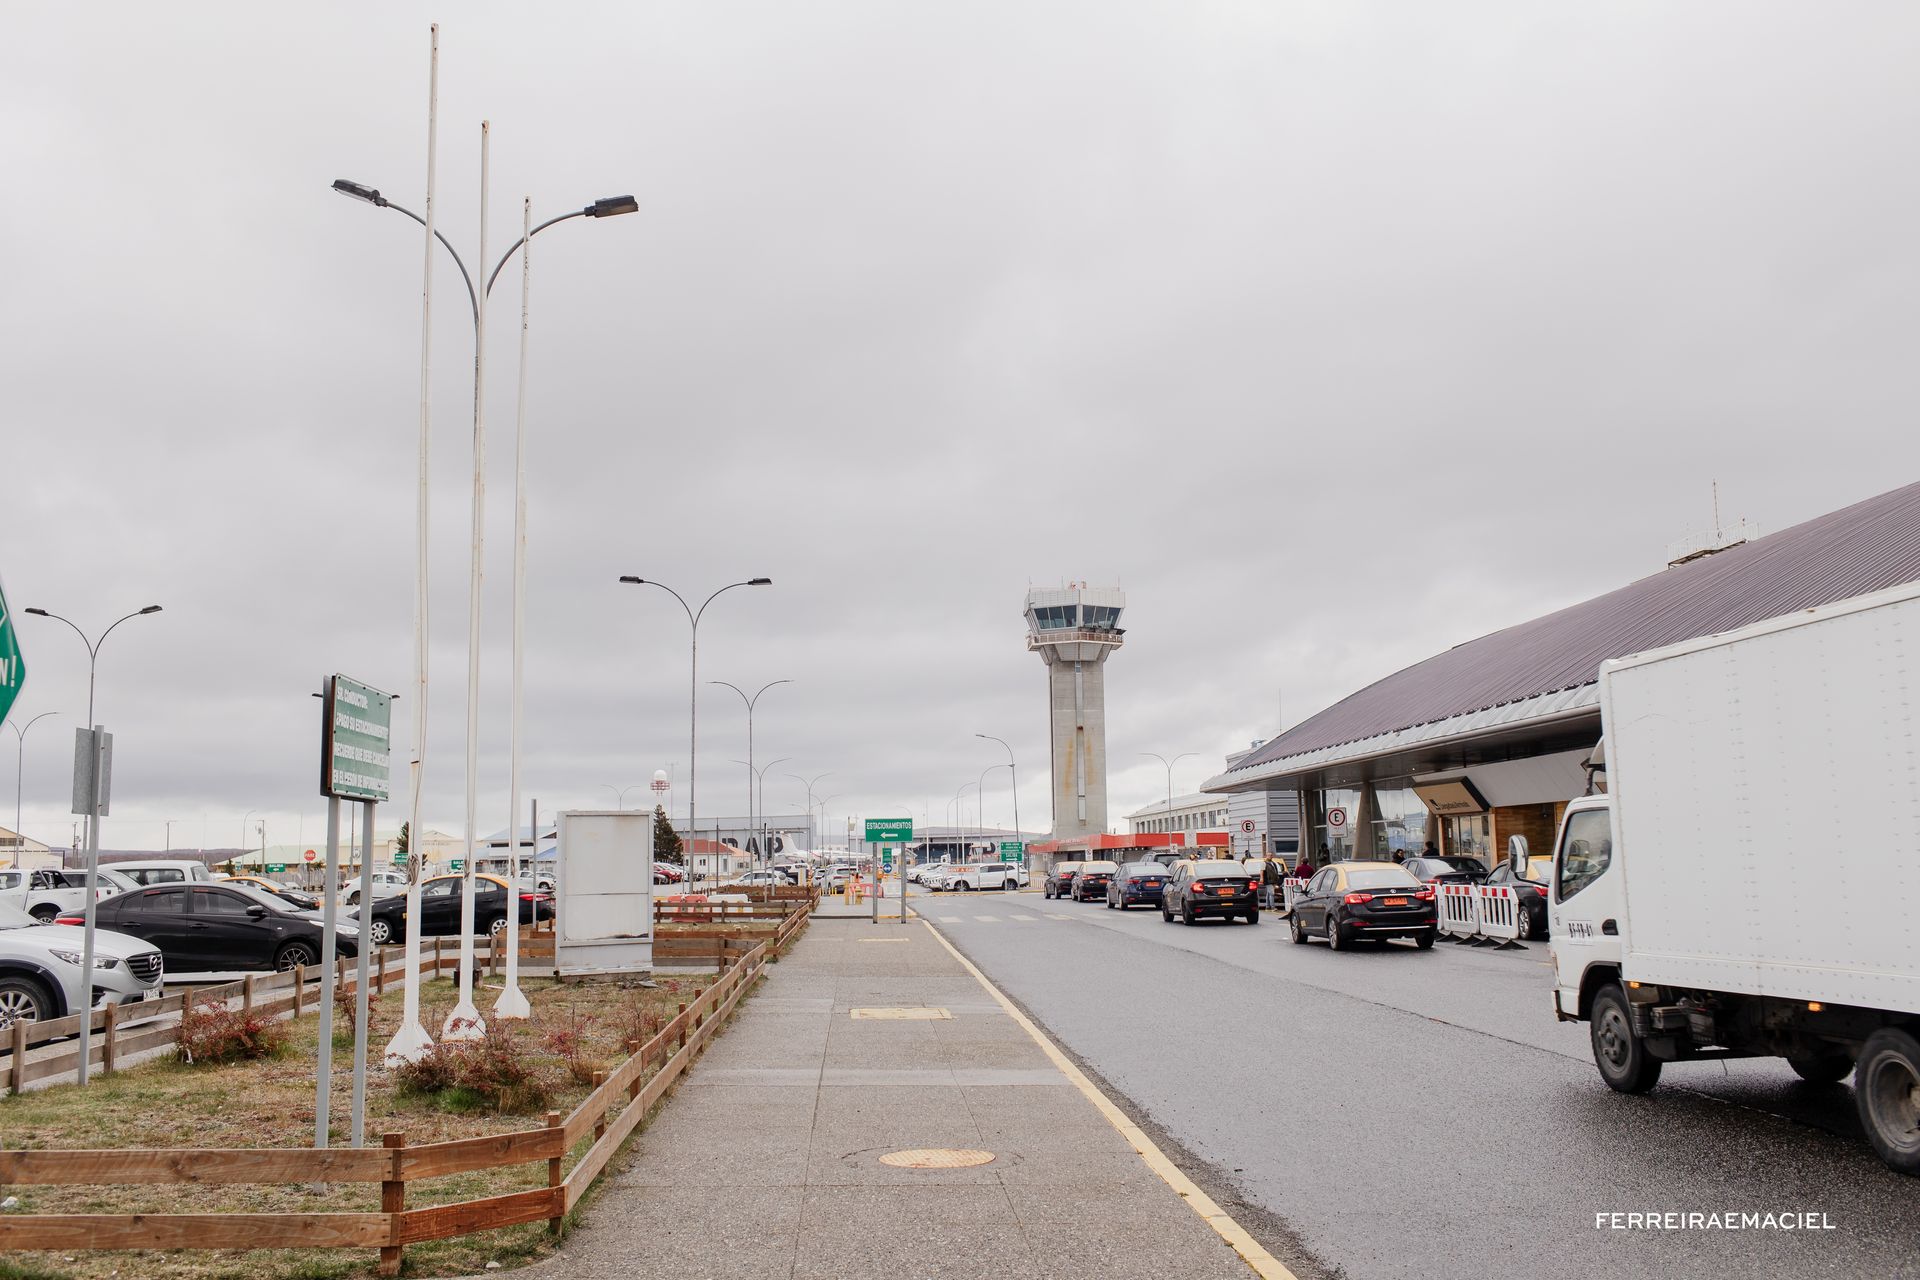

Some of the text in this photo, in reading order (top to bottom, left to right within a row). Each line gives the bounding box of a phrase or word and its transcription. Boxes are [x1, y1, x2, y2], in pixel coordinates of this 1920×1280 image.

[1334, 812, 1340, 822] E
[866, 821, 912, 830] ESTACIONAMIENTOS
[1246, 823, 1251, 831] E
